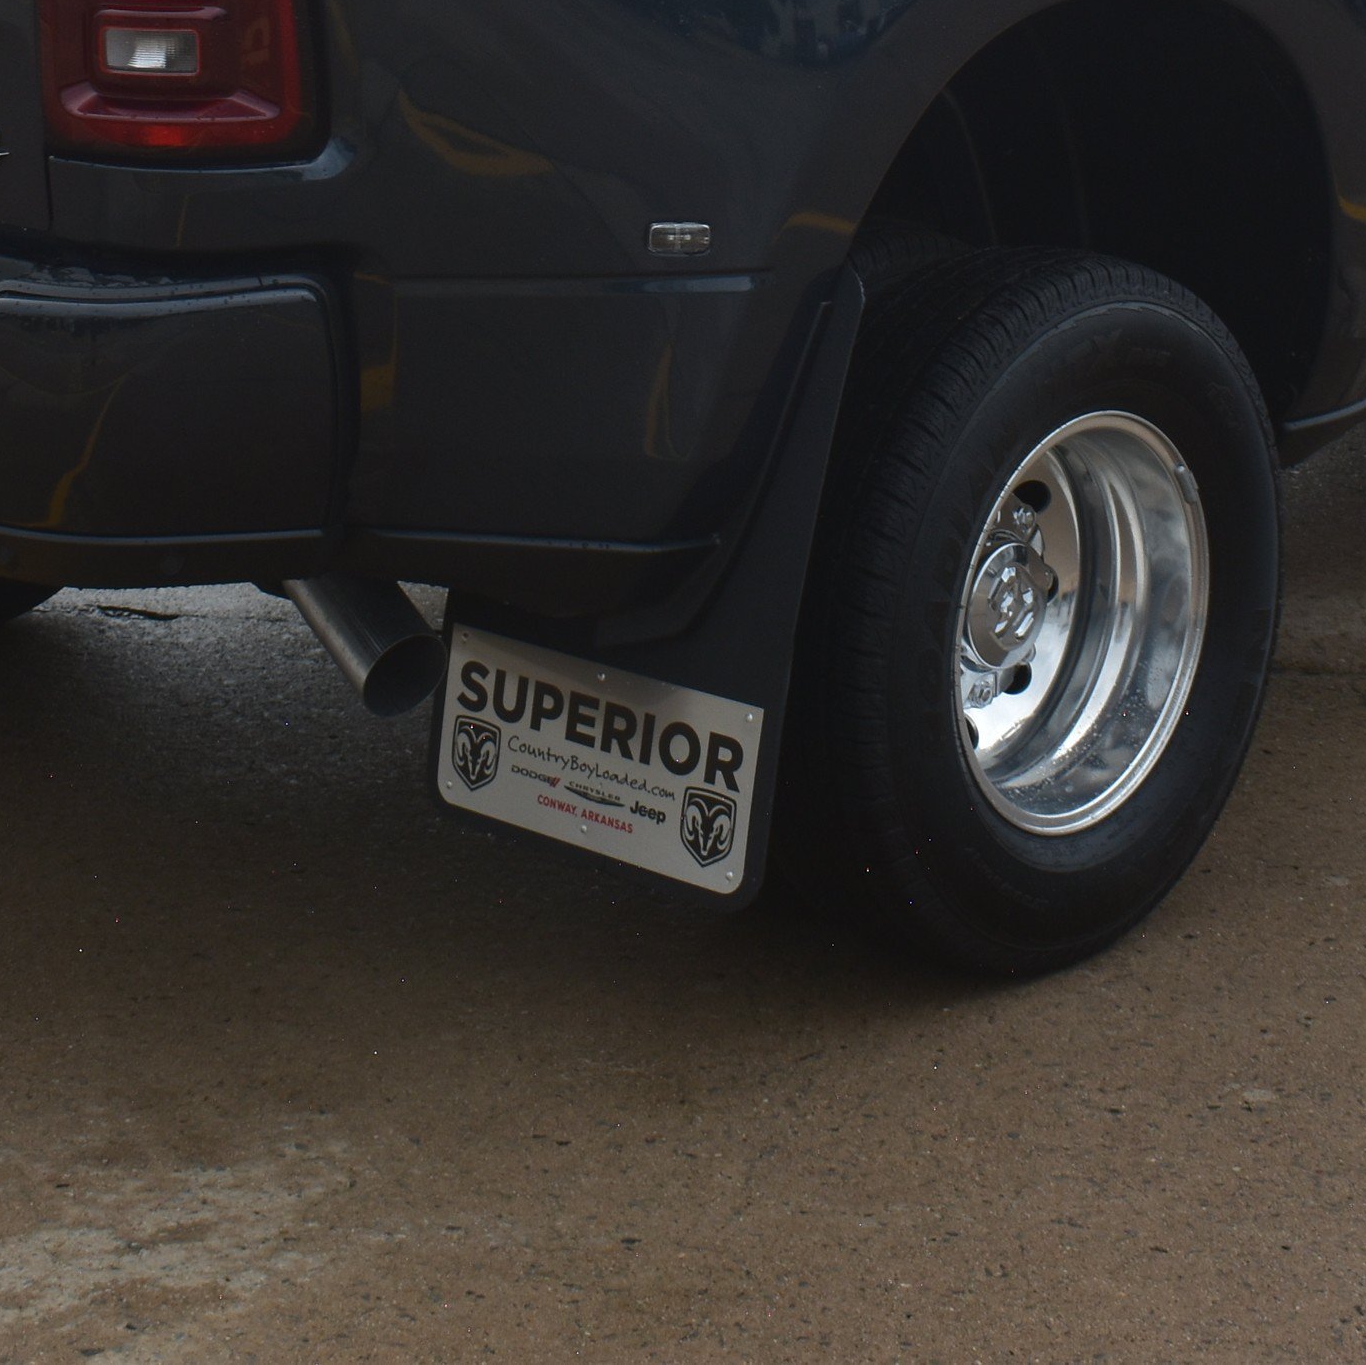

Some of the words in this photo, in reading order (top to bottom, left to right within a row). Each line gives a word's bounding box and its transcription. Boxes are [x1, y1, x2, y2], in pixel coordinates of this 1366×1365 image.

[457, 660, 744, 793] SUPERIOR
[508, 735, 676, 801] CountryBoyLoaded.com
[537, 794, 578, 817] CONWAY,
[581, 808, 634, 834] ARKANSAS
[569, 780, 621, 802] CHRYSLER
[630, 800, 667, 825] Jeep
